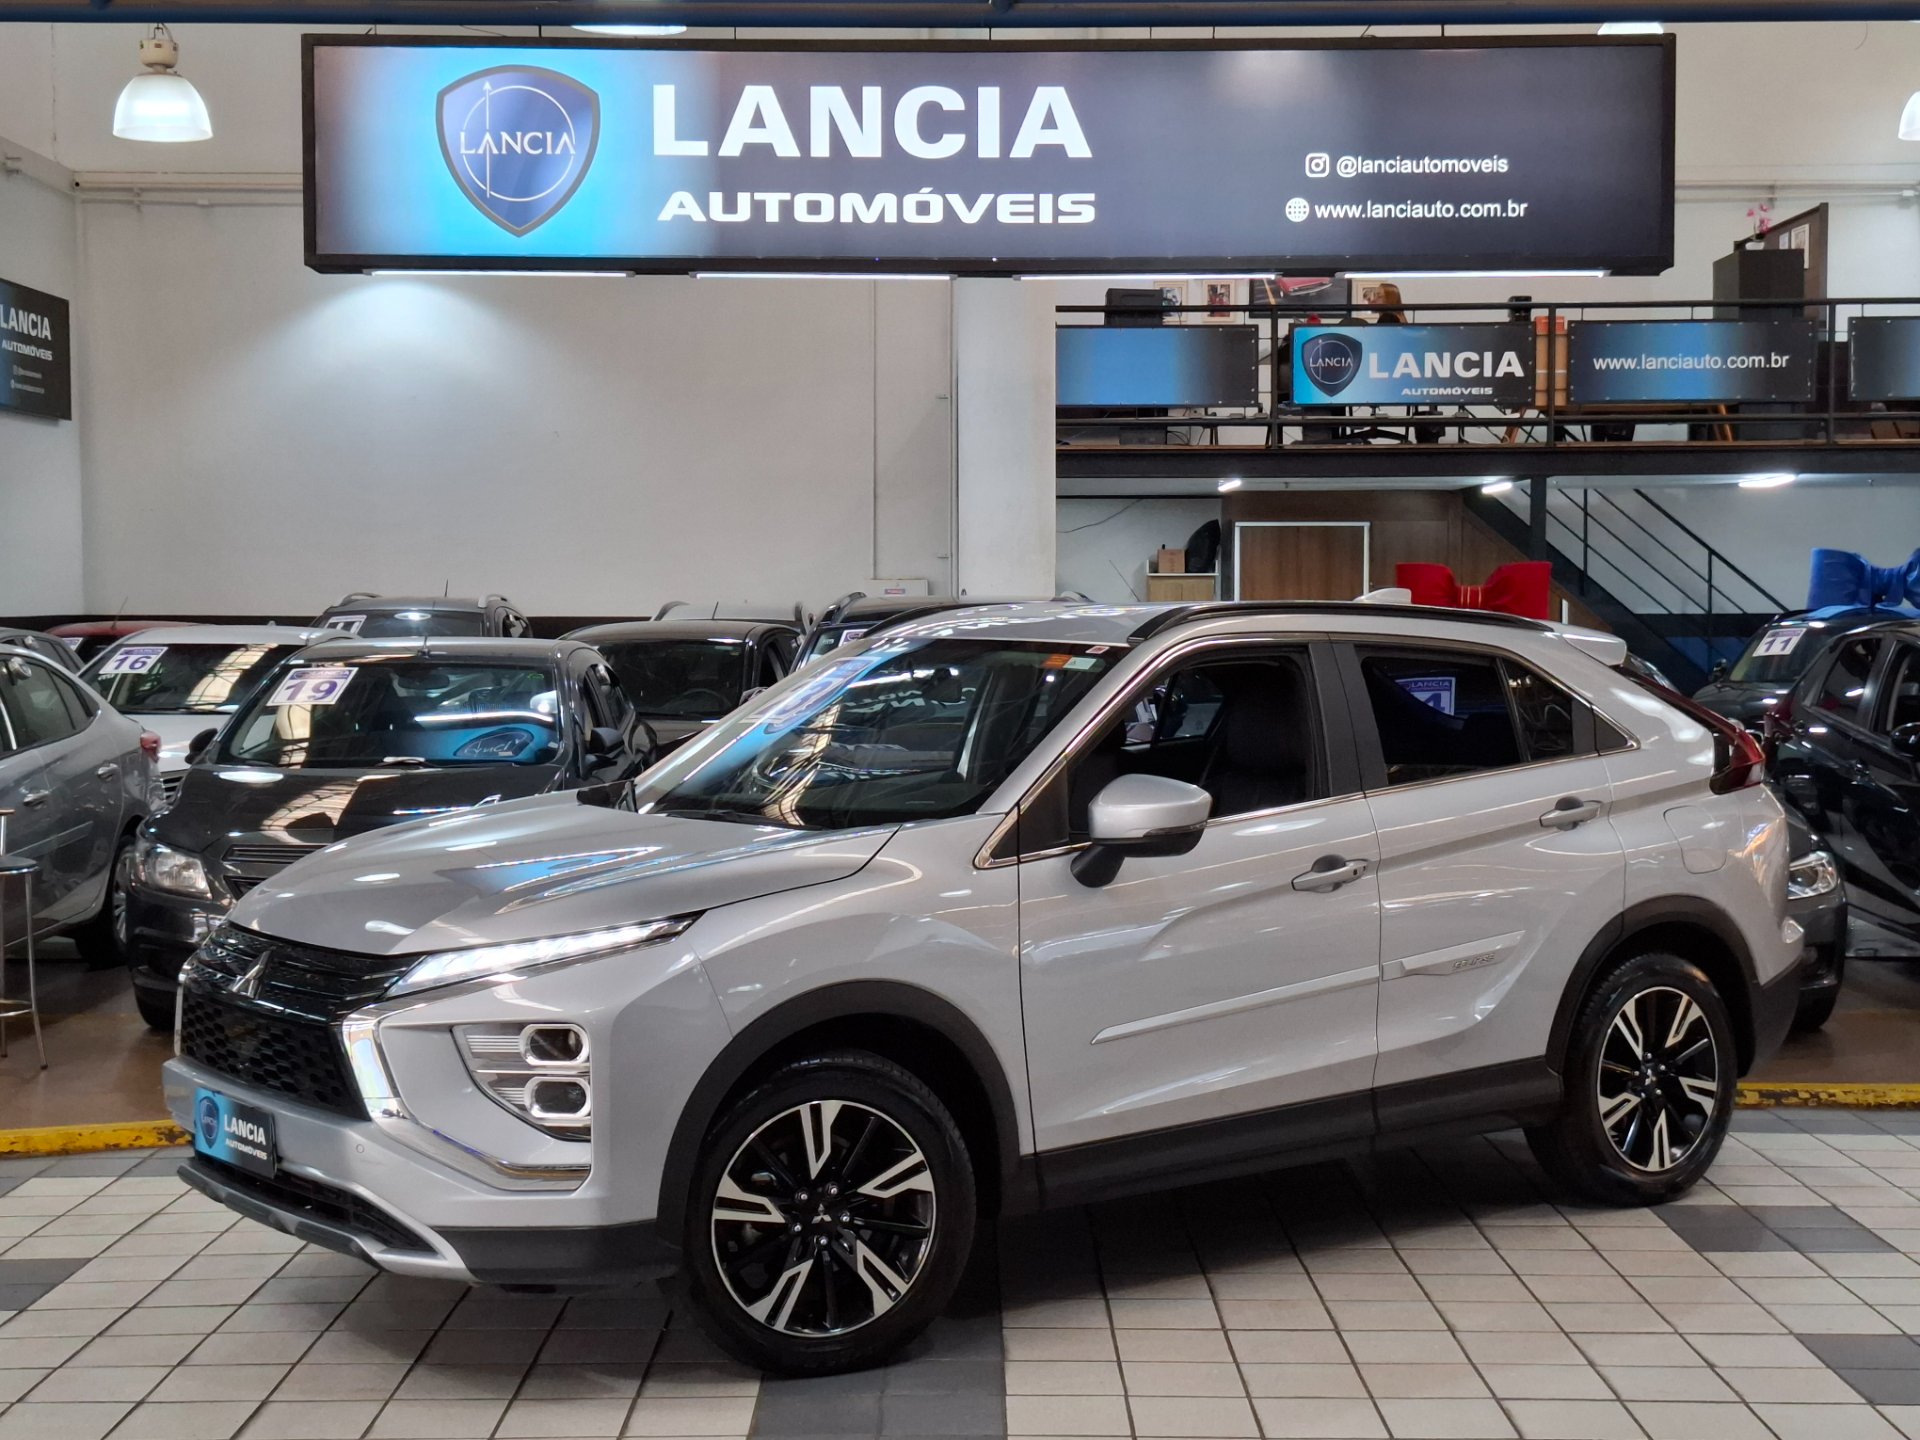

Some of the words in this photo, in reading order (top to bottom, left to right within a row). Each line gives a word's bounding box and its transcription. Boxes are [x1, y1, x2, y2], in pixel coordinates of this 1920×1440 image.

[652, 84, 1093, 159] LANCIA
[460, 130, 576, 155] LANCIA
[1336, 154, 1509, 178] @lanciautomoveis
[657, 186, 1096, 224] AUTOMÓVEIS
[1314, 198, 1528, 219] www.lanciauto.com.br
[0, 304, 52, 341] LANCIA
[1309, 357, 1354, 368] LANCIA
[1368, 351, 1525, 379] LANCIA
[1593, 352, 1790, 371] www.lanciauto.com.br
[1401, 386, 1493, 396] AUTOMÓVEIS
[1764, 637, 1793, 653] 11
[113, 655, 152, 670] 16
[285, 680, 338, 701] 19
[224, 1113, 267, 1146] LANCIA
